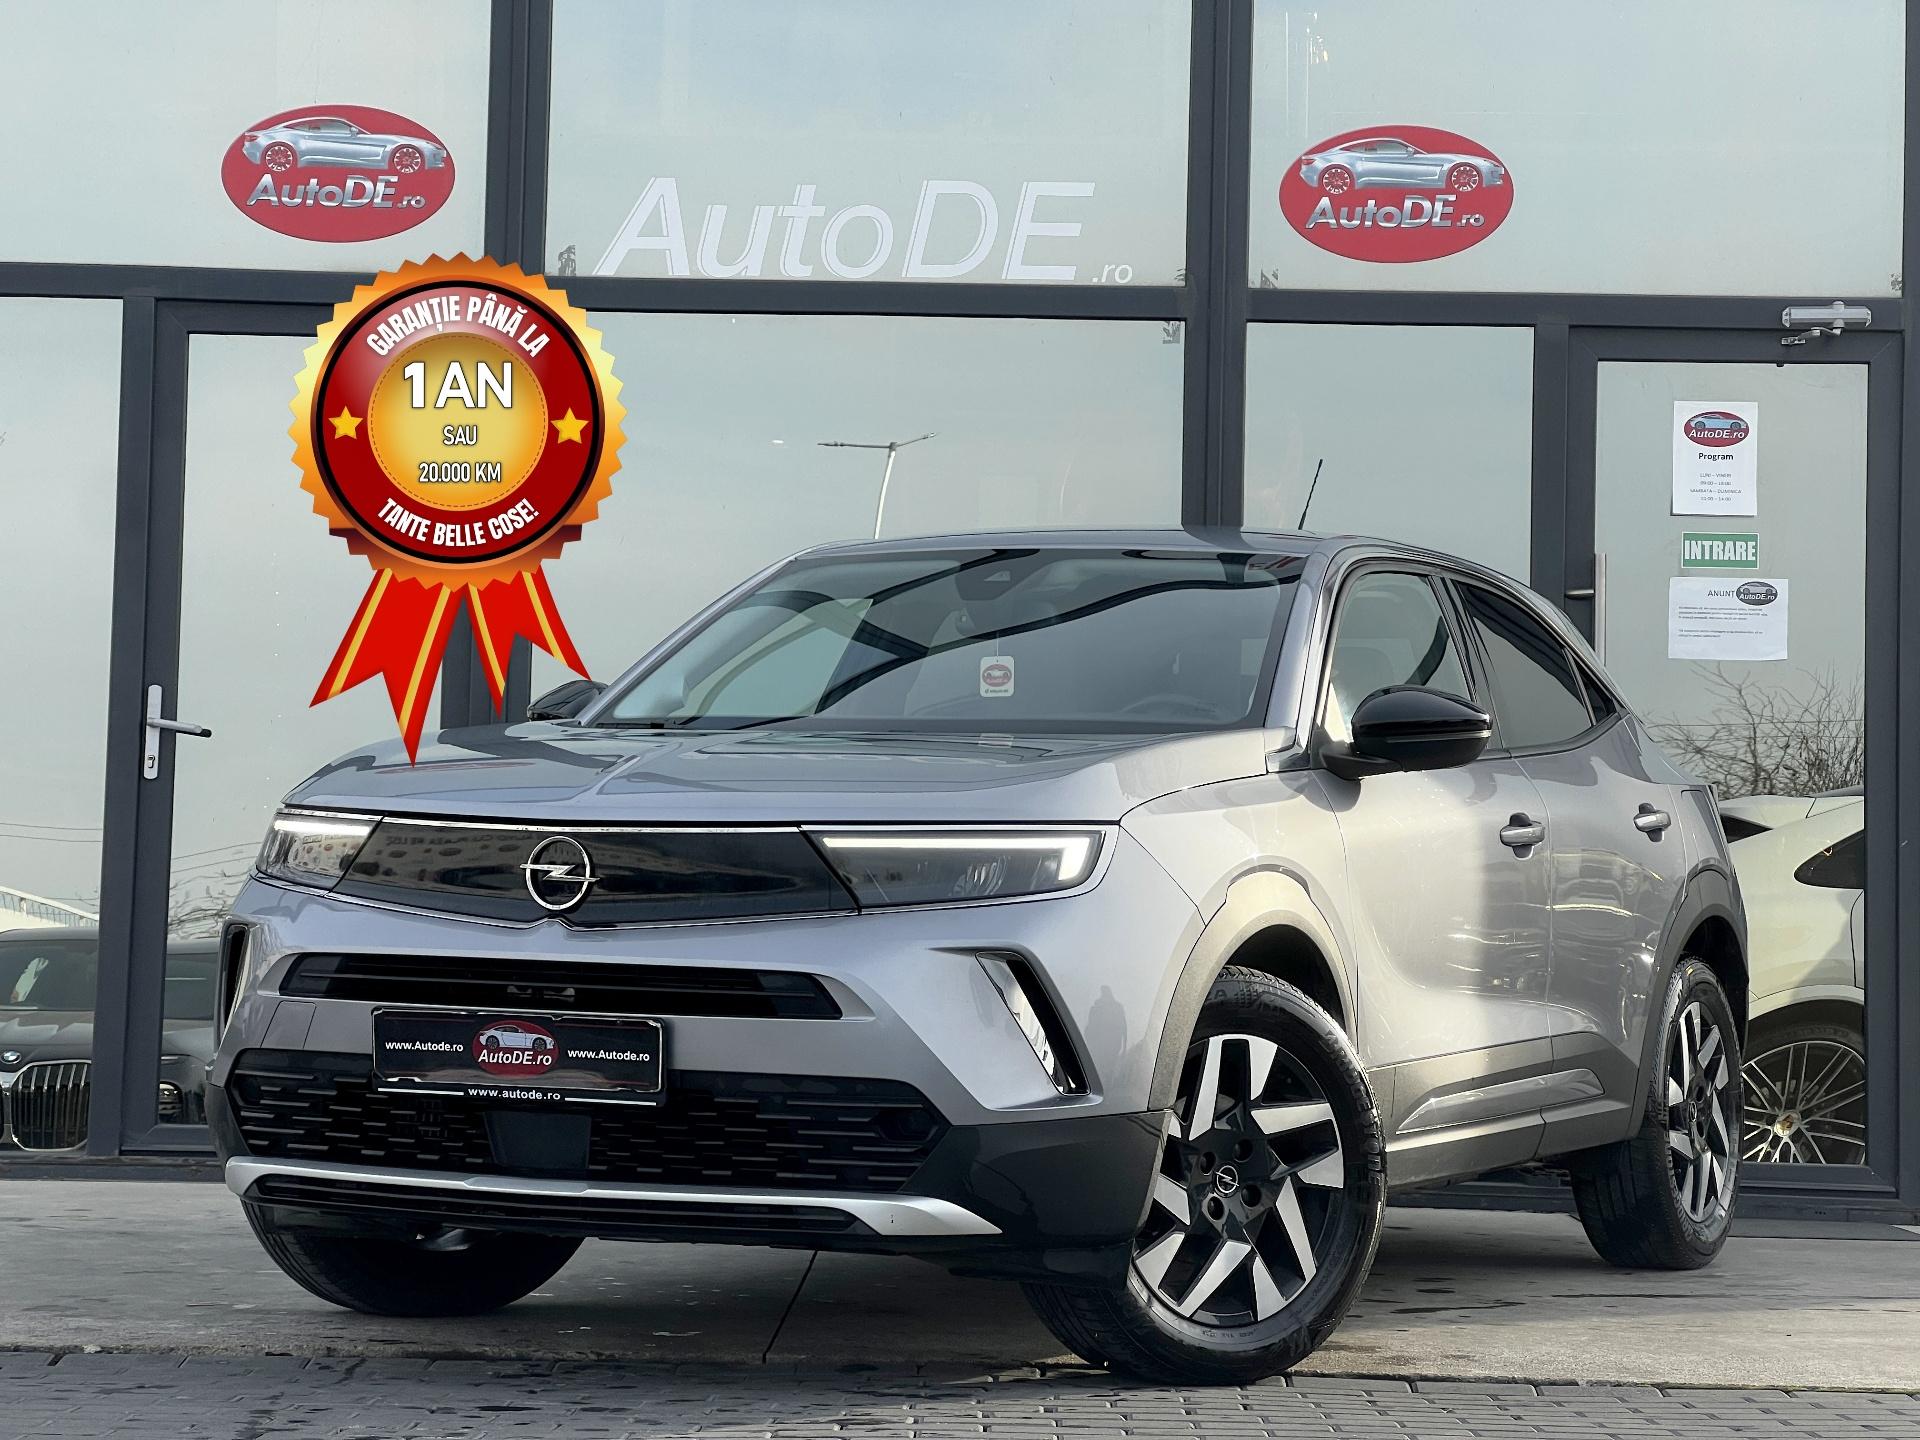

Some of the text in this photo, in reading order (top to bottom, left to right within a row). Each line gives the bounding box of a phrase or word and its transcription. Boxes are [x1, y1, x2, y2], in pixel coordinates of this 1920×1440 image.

[1689, 429, 1745, 439] AutoDE.ro
[1698, 452, 1734, 462] Program
[1684, 540, 1756, 561] INTRARE
[1739, 593, 1775, 601] AutoDE.ro
[385, 1040, 464, 1052] www.Autode.ro
[478, 1050, 552, 1066] AutoDE.ro
[567, 1049, 650, 1062] www.Autode.ro
[467, 1087, 561, 1100] www.autode.ro
